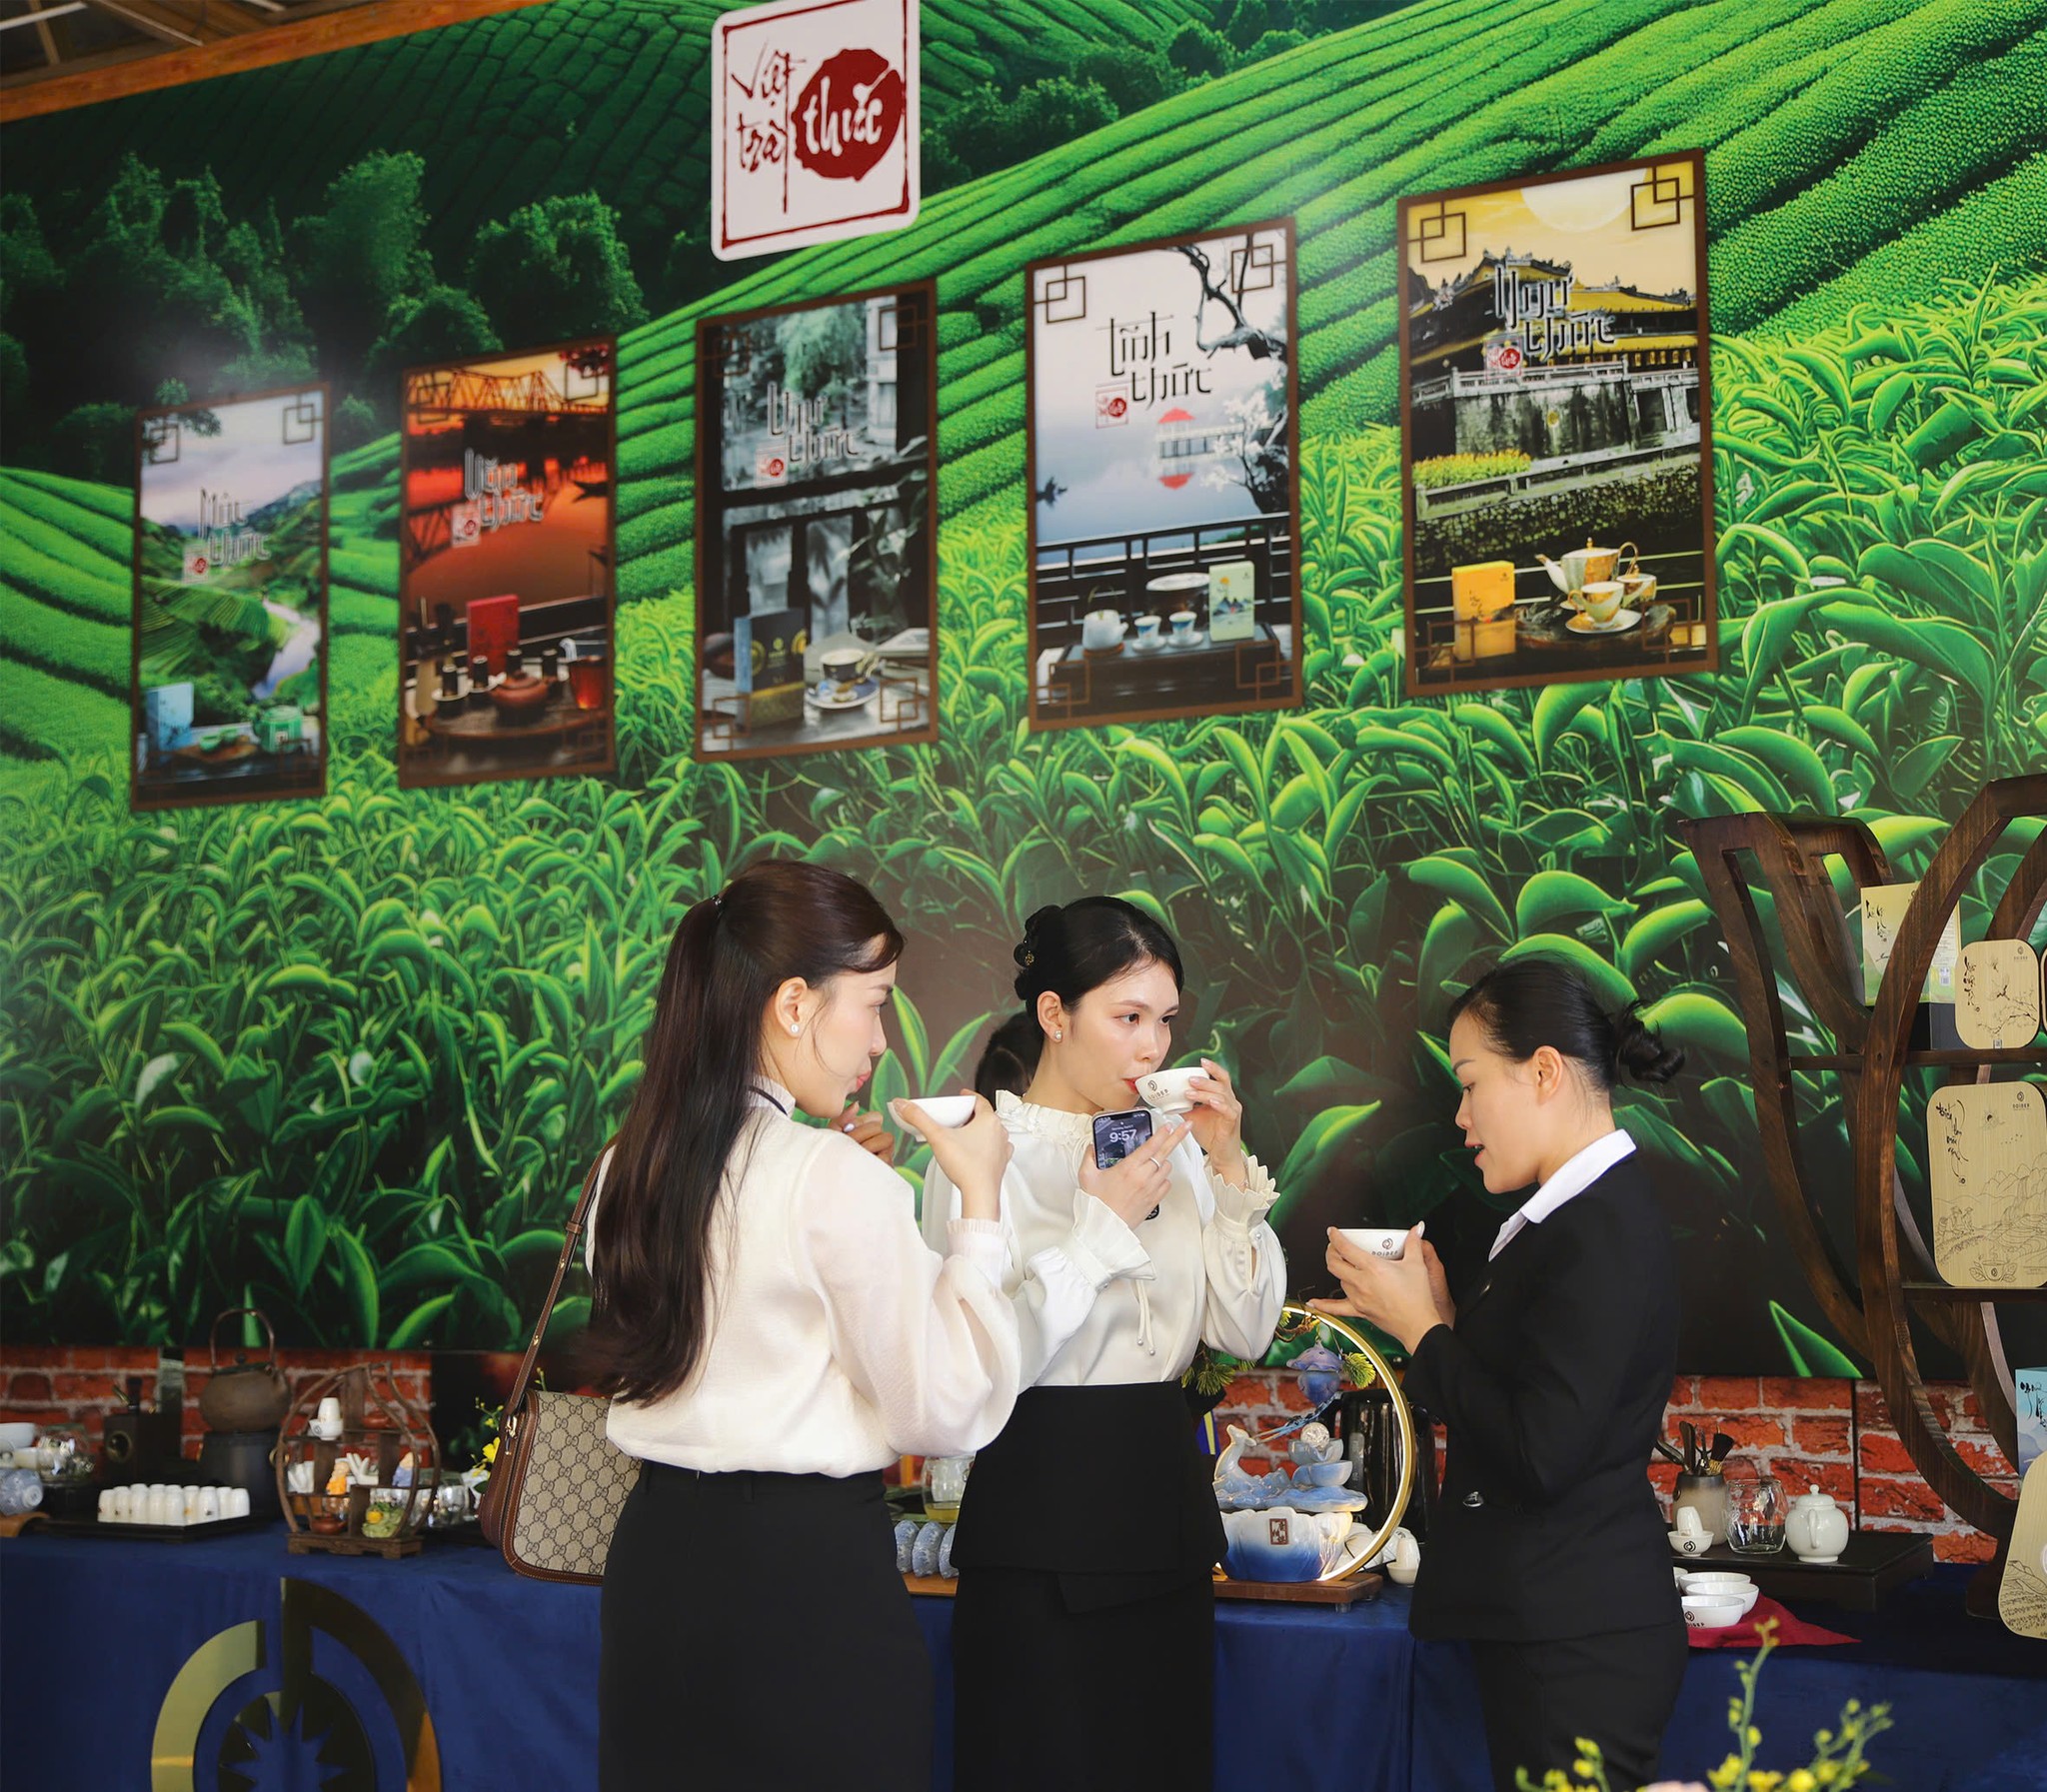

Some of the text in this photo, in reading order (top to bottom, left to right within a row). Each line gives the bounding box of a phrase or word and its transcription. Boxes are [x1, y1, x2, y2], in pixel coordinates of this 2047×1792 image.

[731, 42, 806, 106] Việt
[737, 112, 788, 173] trà
[1109, 1129, 1136, 1142] 9:57
